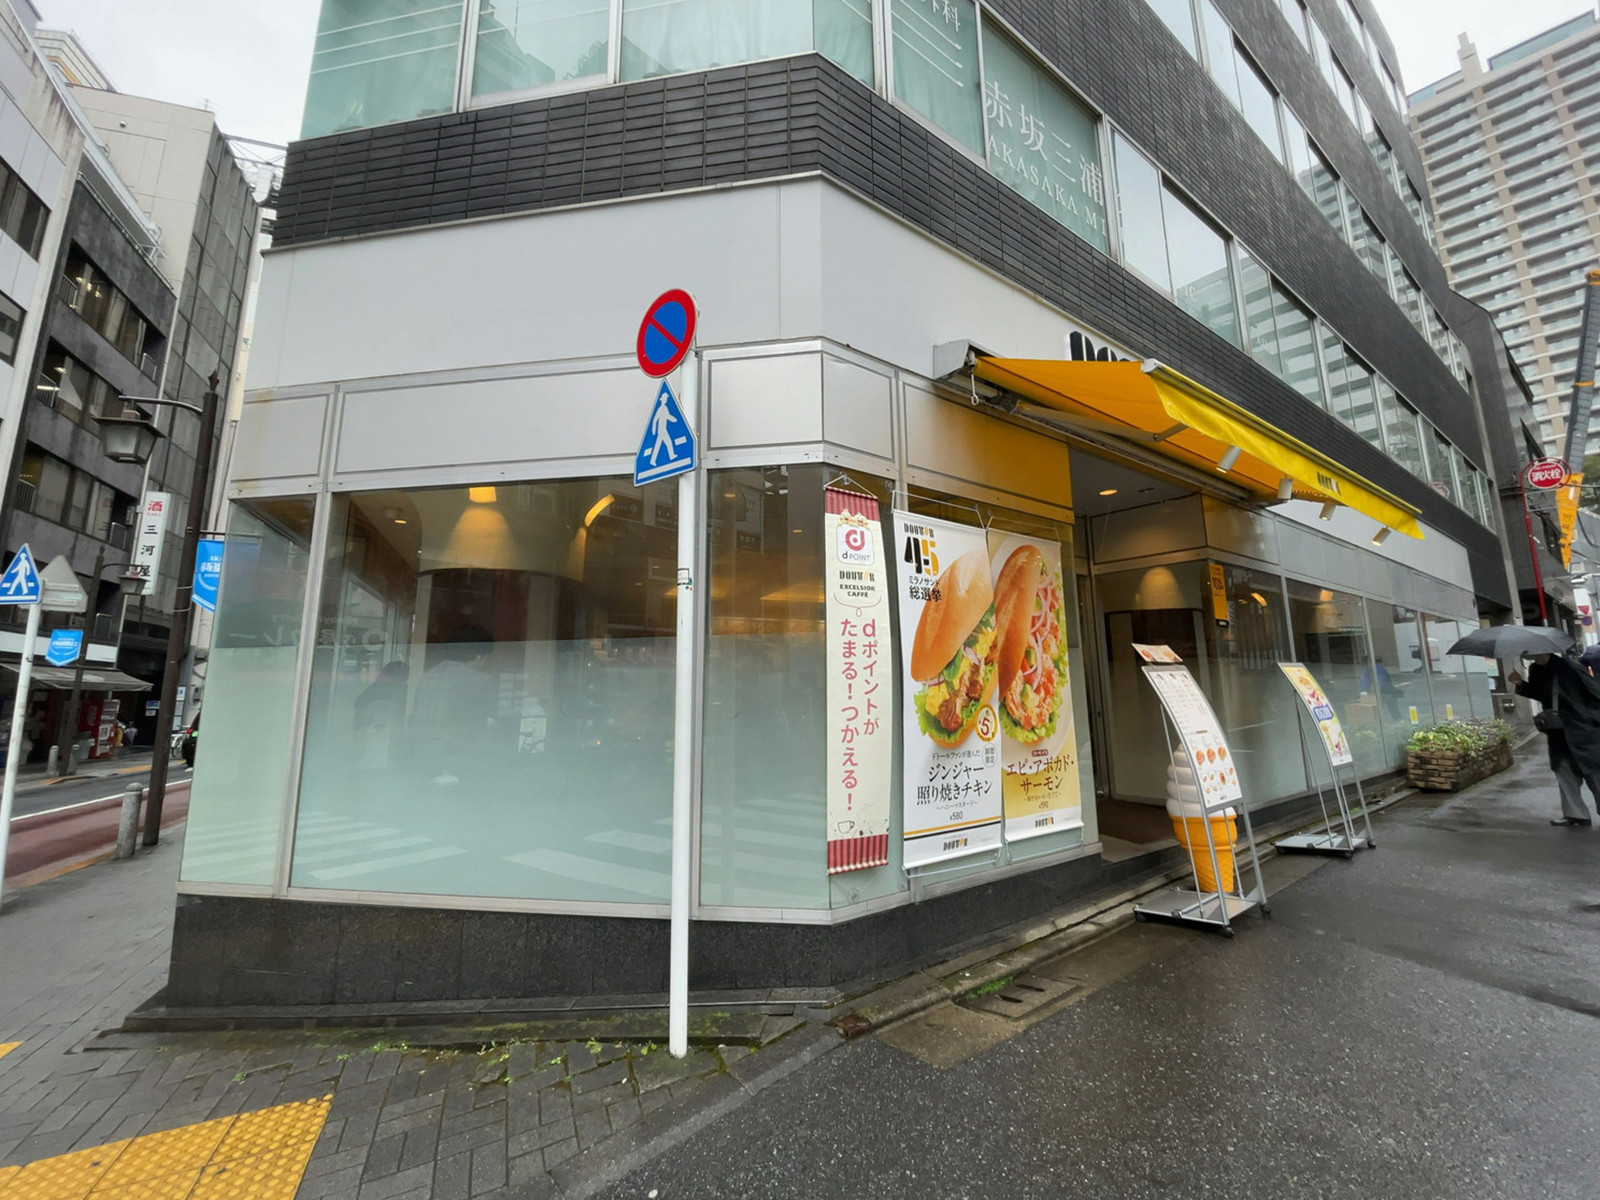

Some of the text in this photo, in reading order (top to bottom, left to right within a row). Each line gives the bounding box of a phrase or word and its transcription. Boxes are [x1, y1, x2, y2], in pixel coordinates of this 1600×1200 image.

[986, 135, 1079, 216] AKASAKA
[1532, 469, 1561, 482] 消火栓
[147, 500, 163, 512] 酒
[139, 525, 158, 577] 三河屋
[849, 553, 870, 561] POINT
[904, 536, 939, 577] 45
[839, 570, 875, 582] DOUTOR
[839, 583, 876, 591] EXCELSIOR
[909, 585, 942, 602] 総選挙
[862, 618, 880, 736] dポイントが
[928, 761, 984, 783] ジンジャー
[916, 779, 993, 806] 照り焼きチキン
[1020, 775, 1063, 796] サーモン
